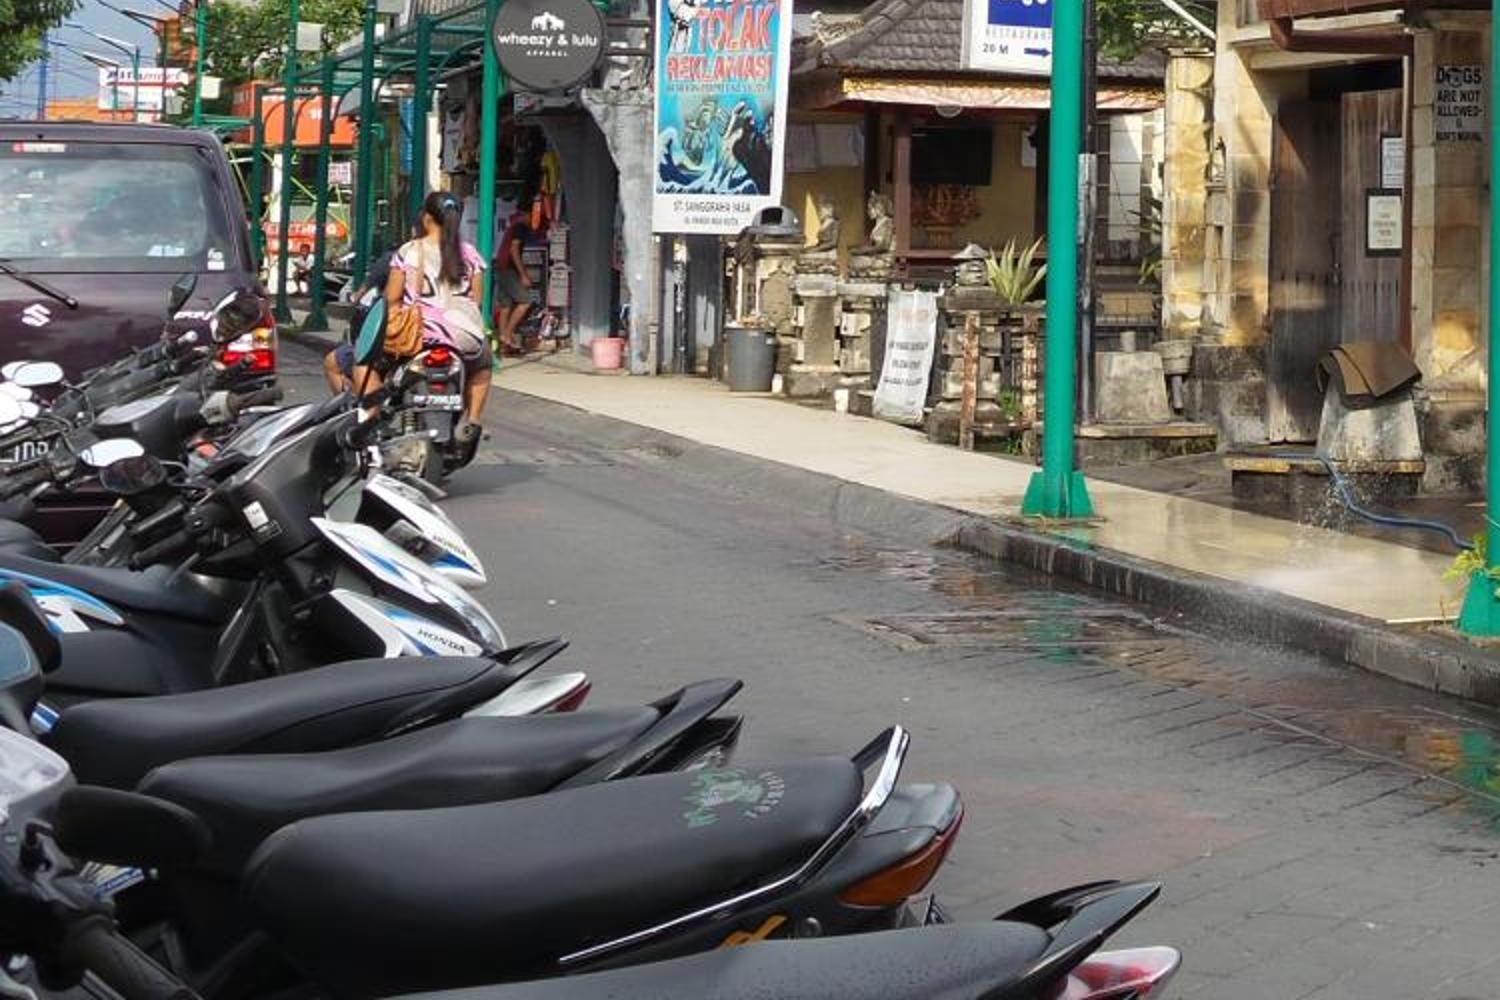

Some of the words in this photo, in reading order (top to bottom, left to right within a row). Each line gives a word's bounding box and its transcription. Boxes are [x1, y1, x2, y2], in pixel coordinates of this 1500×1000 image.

[697, 3, 774, 51] TOLAK
[498, 33, 553, 47] wheezy
[557, 34, 568, 46] &
[572, 33, 597, 47] lulu
[668, 55, 771, 81] REKLAMASI
[1436, 66, 1482, 87] DOGS
[1437, 90, 1457, 103] ARE
[1460, 90, 1481, 103] NOT
[432, 534, 468, 558] HONDA
[417, 629, 466, 653] HONDA
